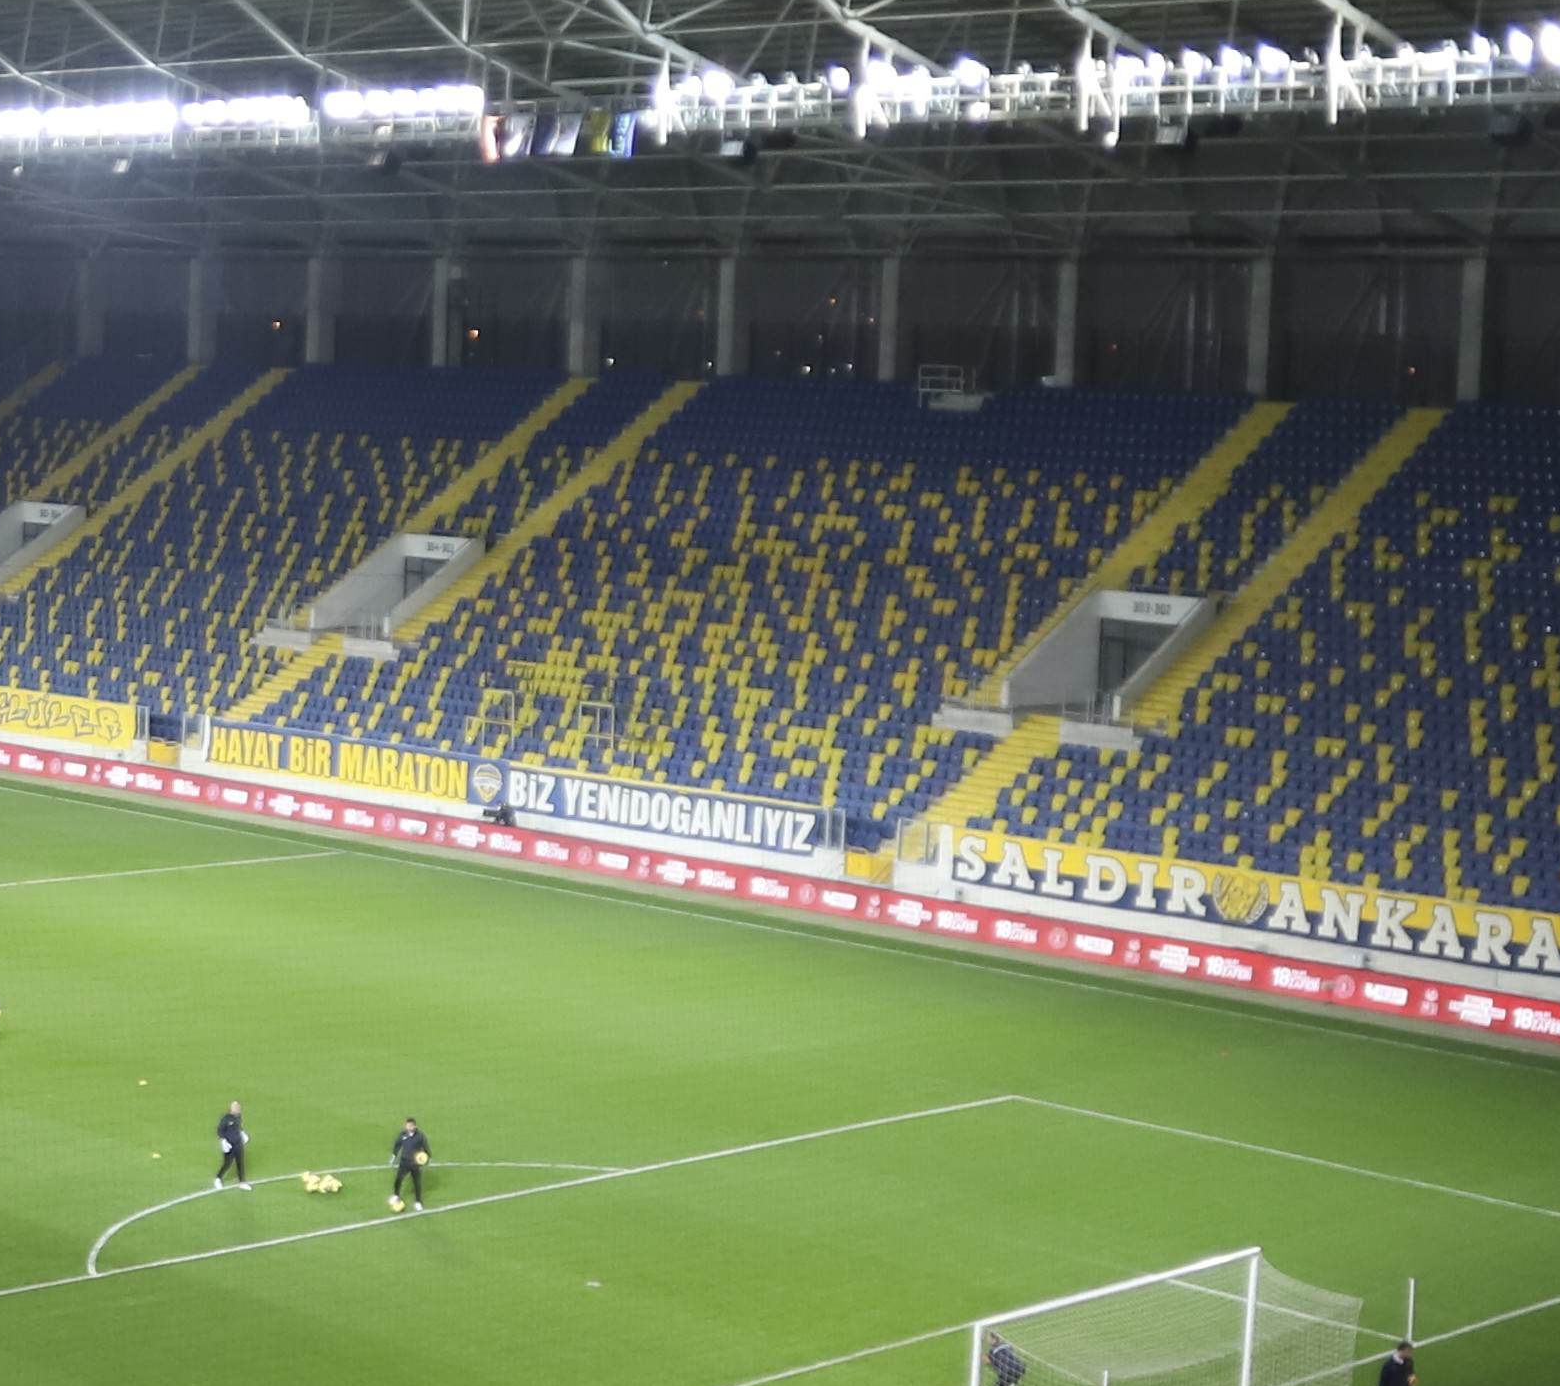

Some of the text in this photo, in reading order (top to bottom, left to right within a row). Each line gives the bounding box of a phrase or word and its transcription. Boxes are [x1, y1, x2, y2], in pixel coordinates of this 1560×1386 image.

[211, 725, 284, 771] HAYAT
[338, 742, 470, 801] MARATON
[955, 832, 1207, 917] SALDIR
[1206, 955, 1224, 977] 18
[1272, 966, 1290, 987] 18
[1513, 1008, 1532, 1030] 18
